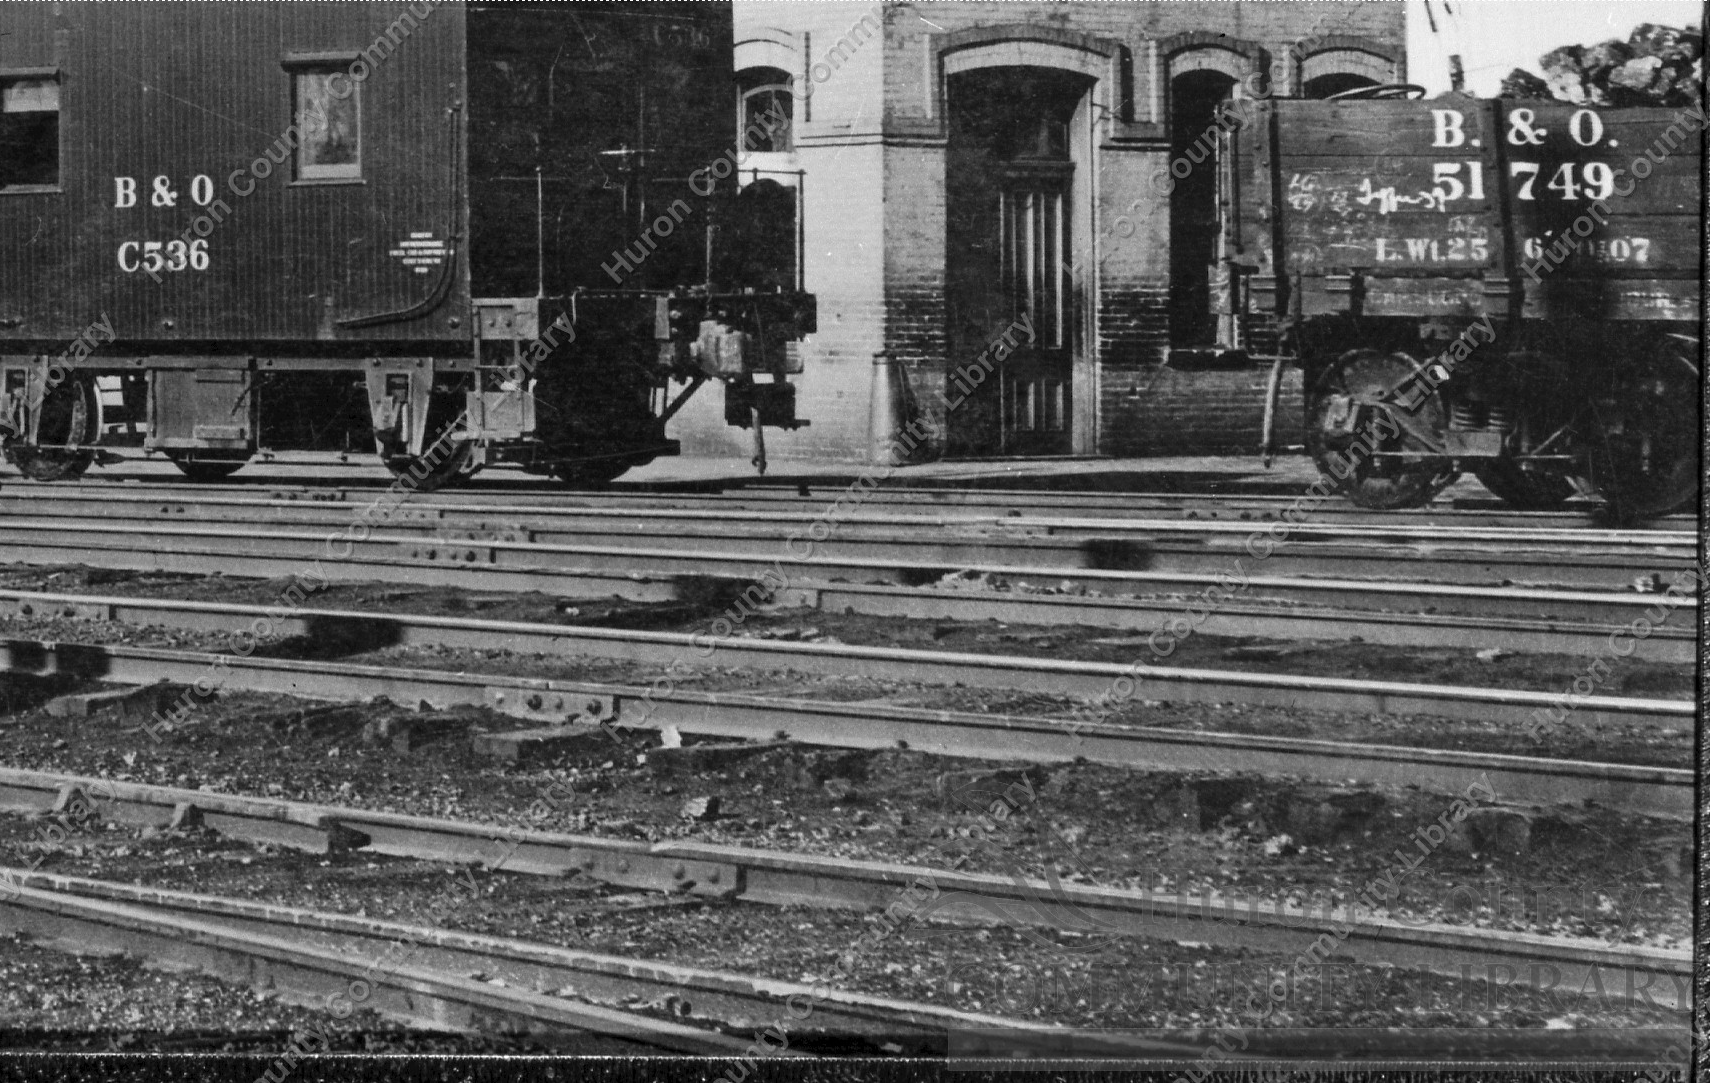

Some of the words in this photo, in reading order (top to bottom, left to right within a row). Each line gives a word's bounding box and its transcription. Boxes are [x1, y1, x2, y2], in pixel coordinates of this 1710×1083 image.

[1507, 107, 1548, 146] &
[114, 176, 137, 208] B
[151, 174, 178, 207] &
[191, 174, 214, 206] O
[117, 238, 210, 272] C536
